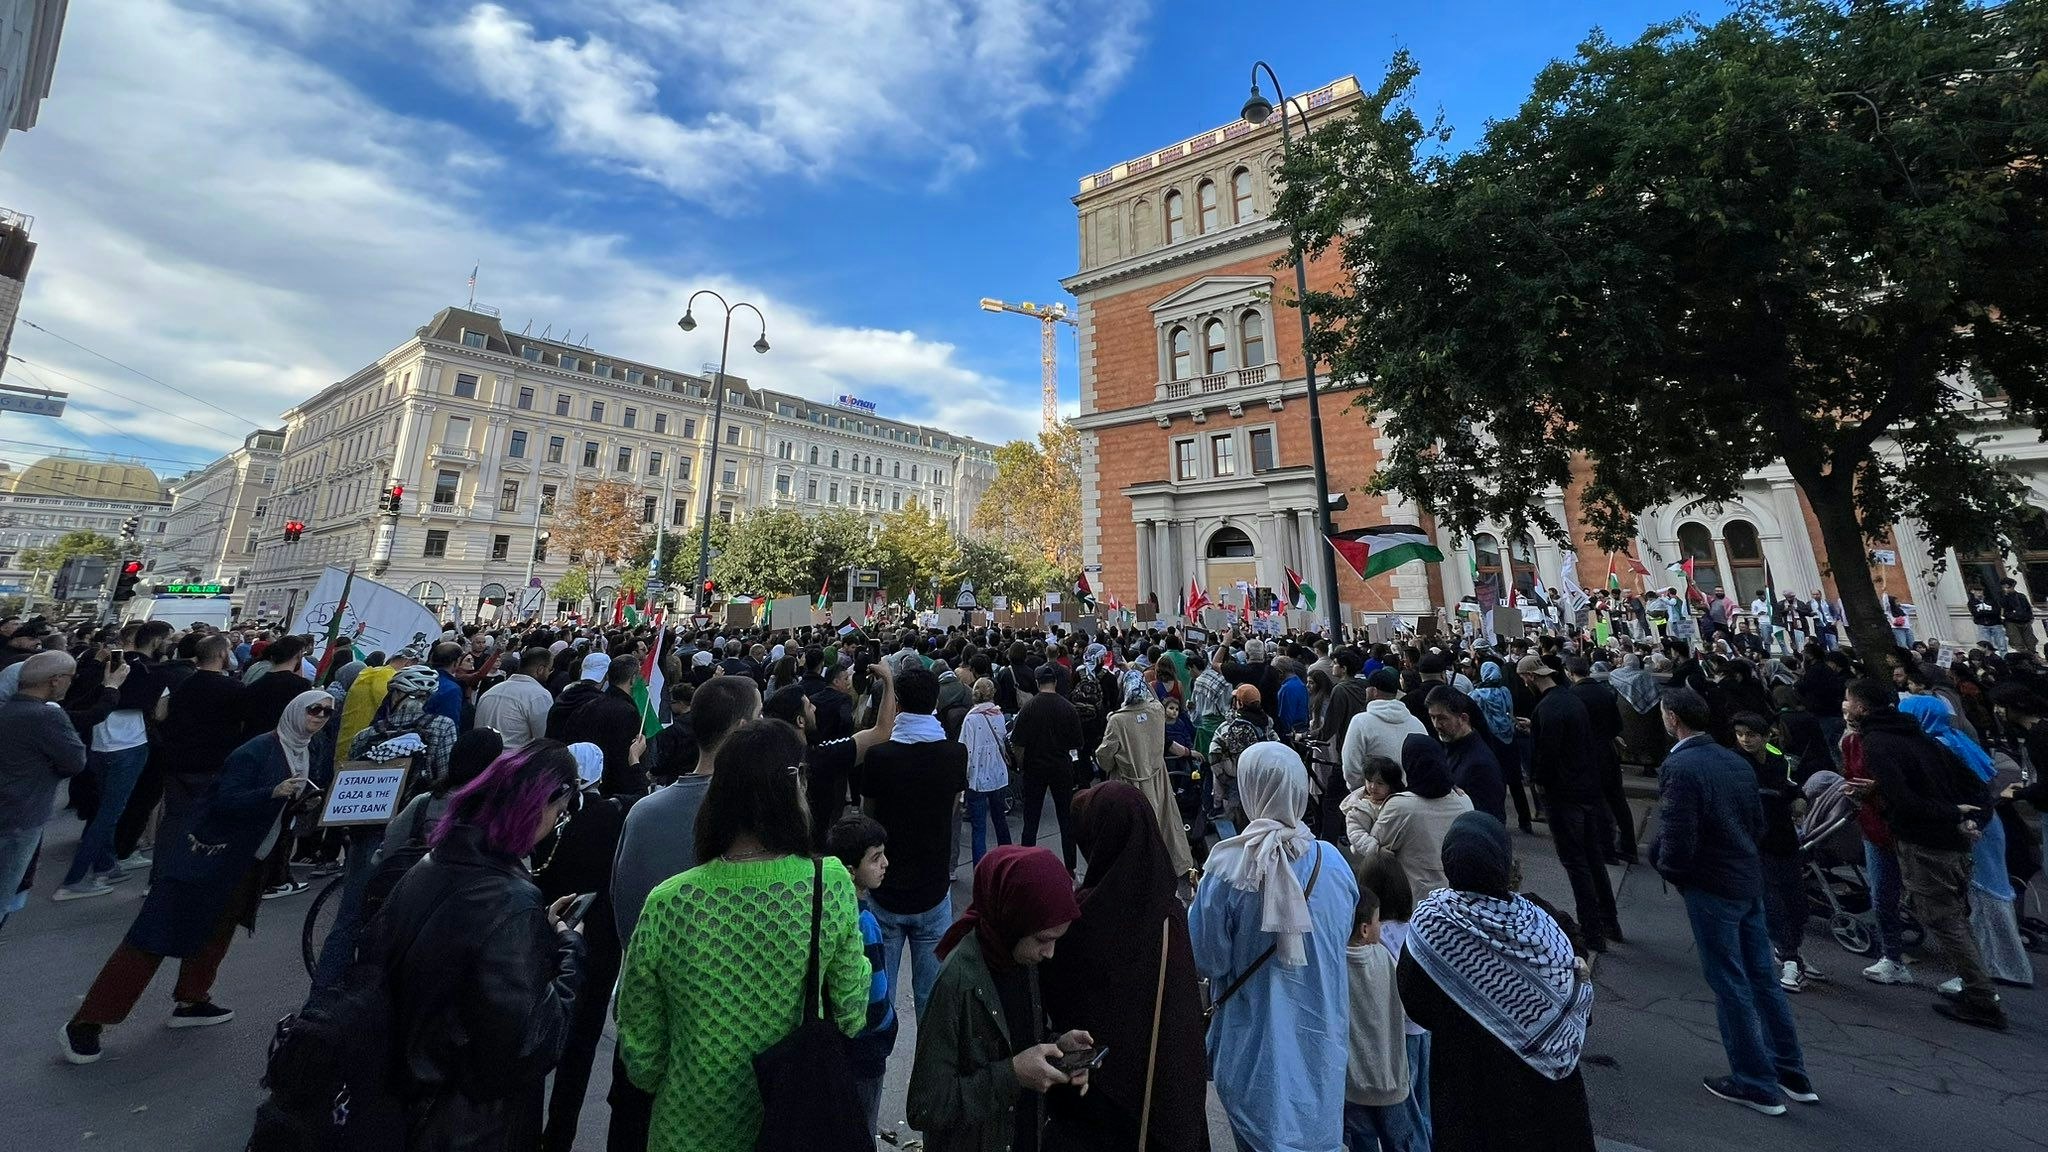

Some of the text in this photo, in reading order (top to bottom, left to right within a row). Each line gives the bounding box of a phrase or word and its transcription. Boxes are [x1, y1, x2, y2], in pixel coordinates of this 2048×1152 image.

[344, 776, 375, 785] STAND
[377, 776, 399, 784] WITH
[338, 791, 363, 799] GAZA
[376, 790, 391, 798] THE
[332, 804, 388, 814] WEST BANK
